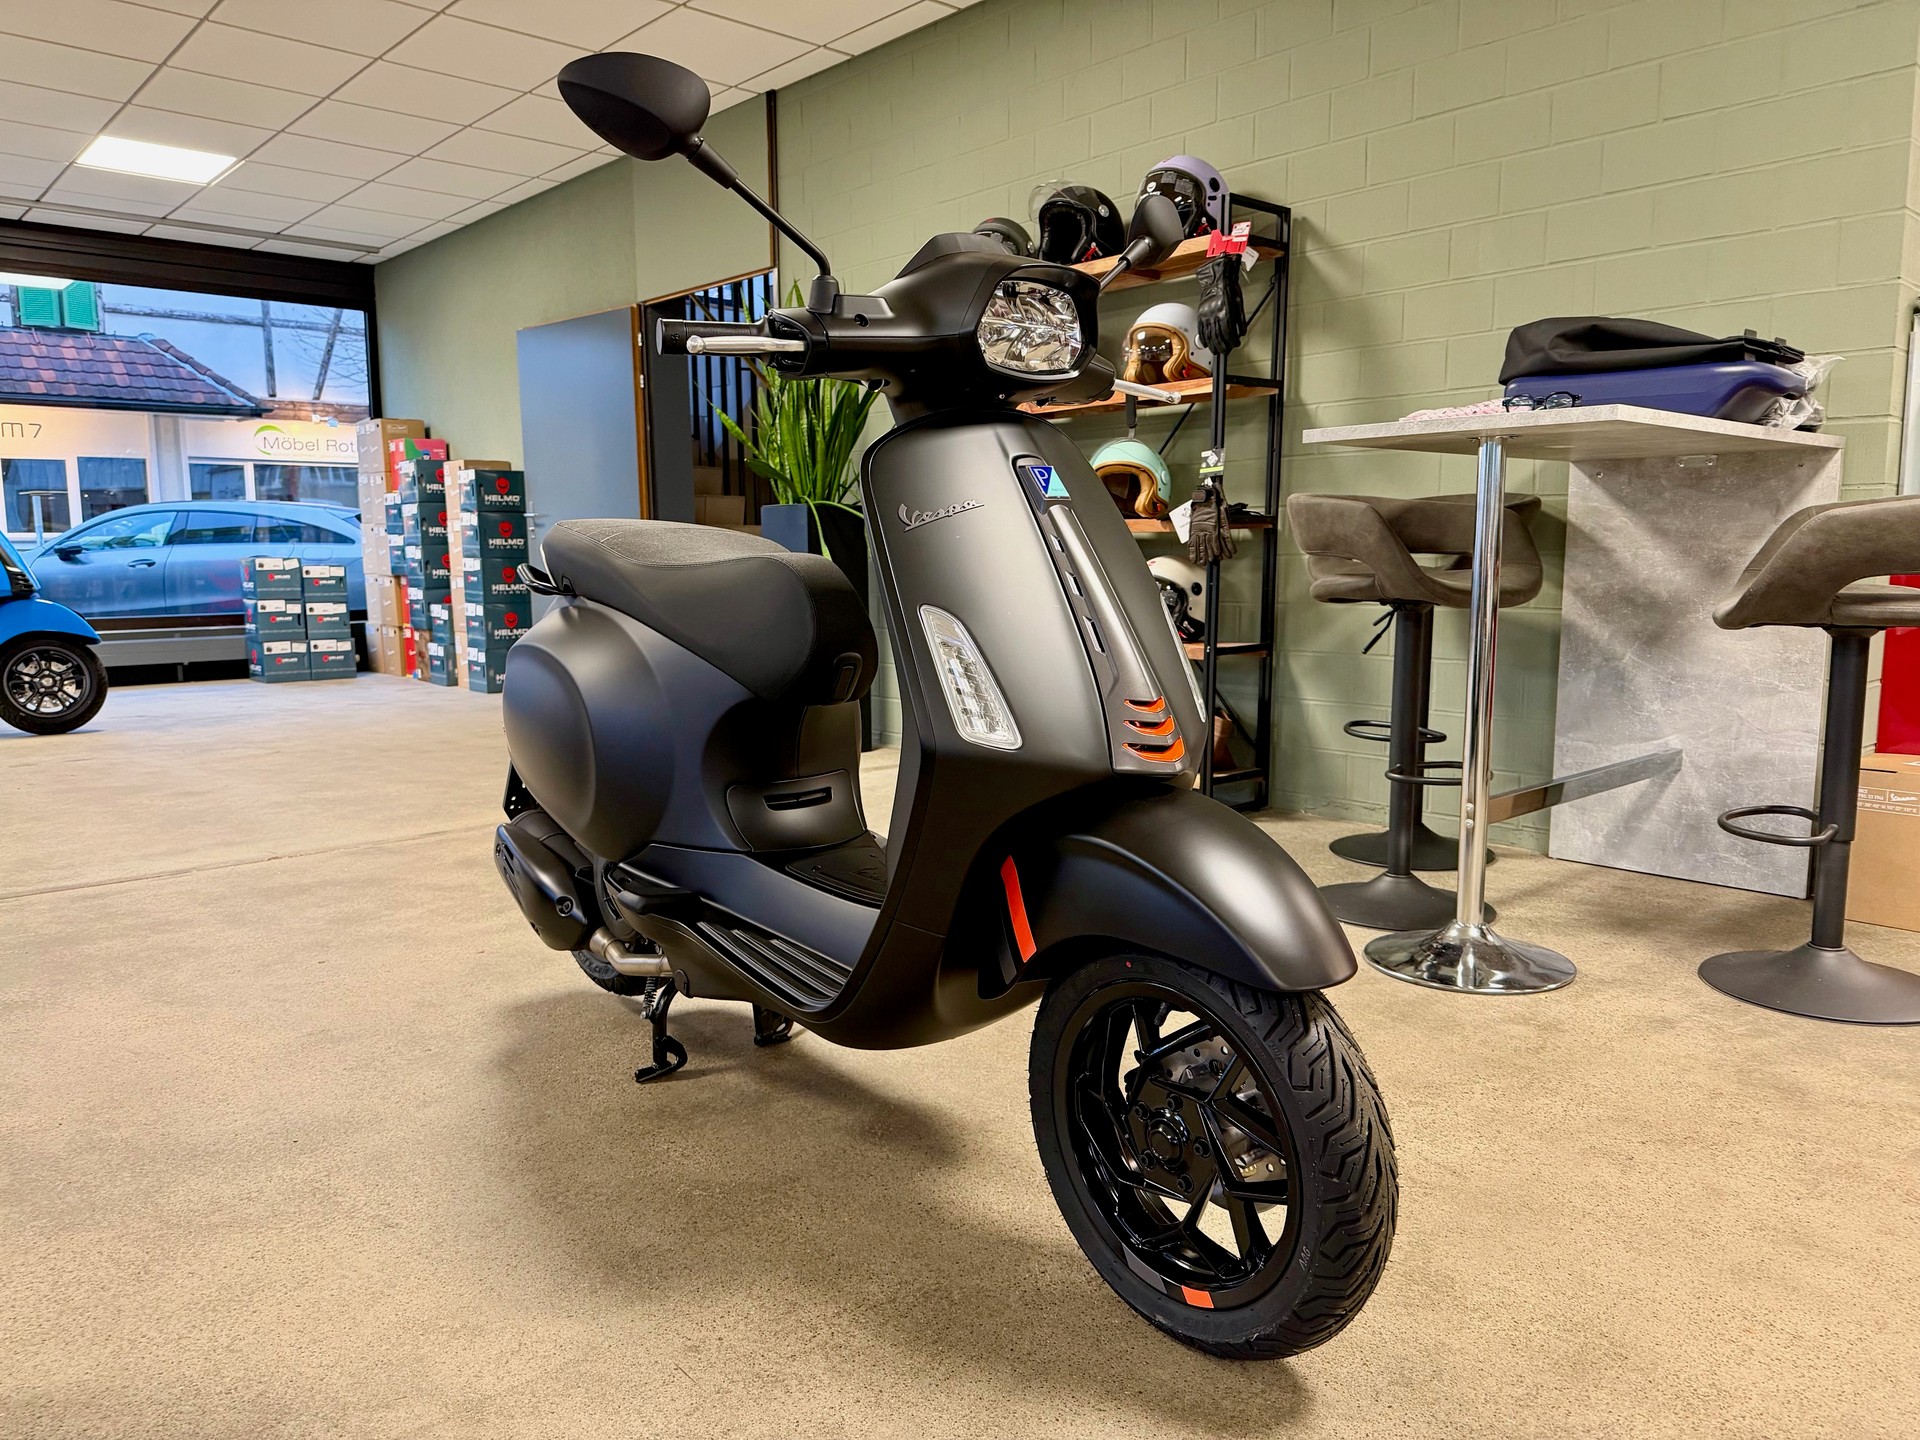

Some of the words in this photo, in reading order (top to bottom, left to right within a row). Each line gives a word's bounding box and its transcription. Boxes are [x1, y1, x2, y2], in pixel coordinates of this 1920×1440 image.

[263, 436, 320, 451] Möbel
[484, 494, 520, 502] HELMO
[897, 499, 984, 533] Vespa
